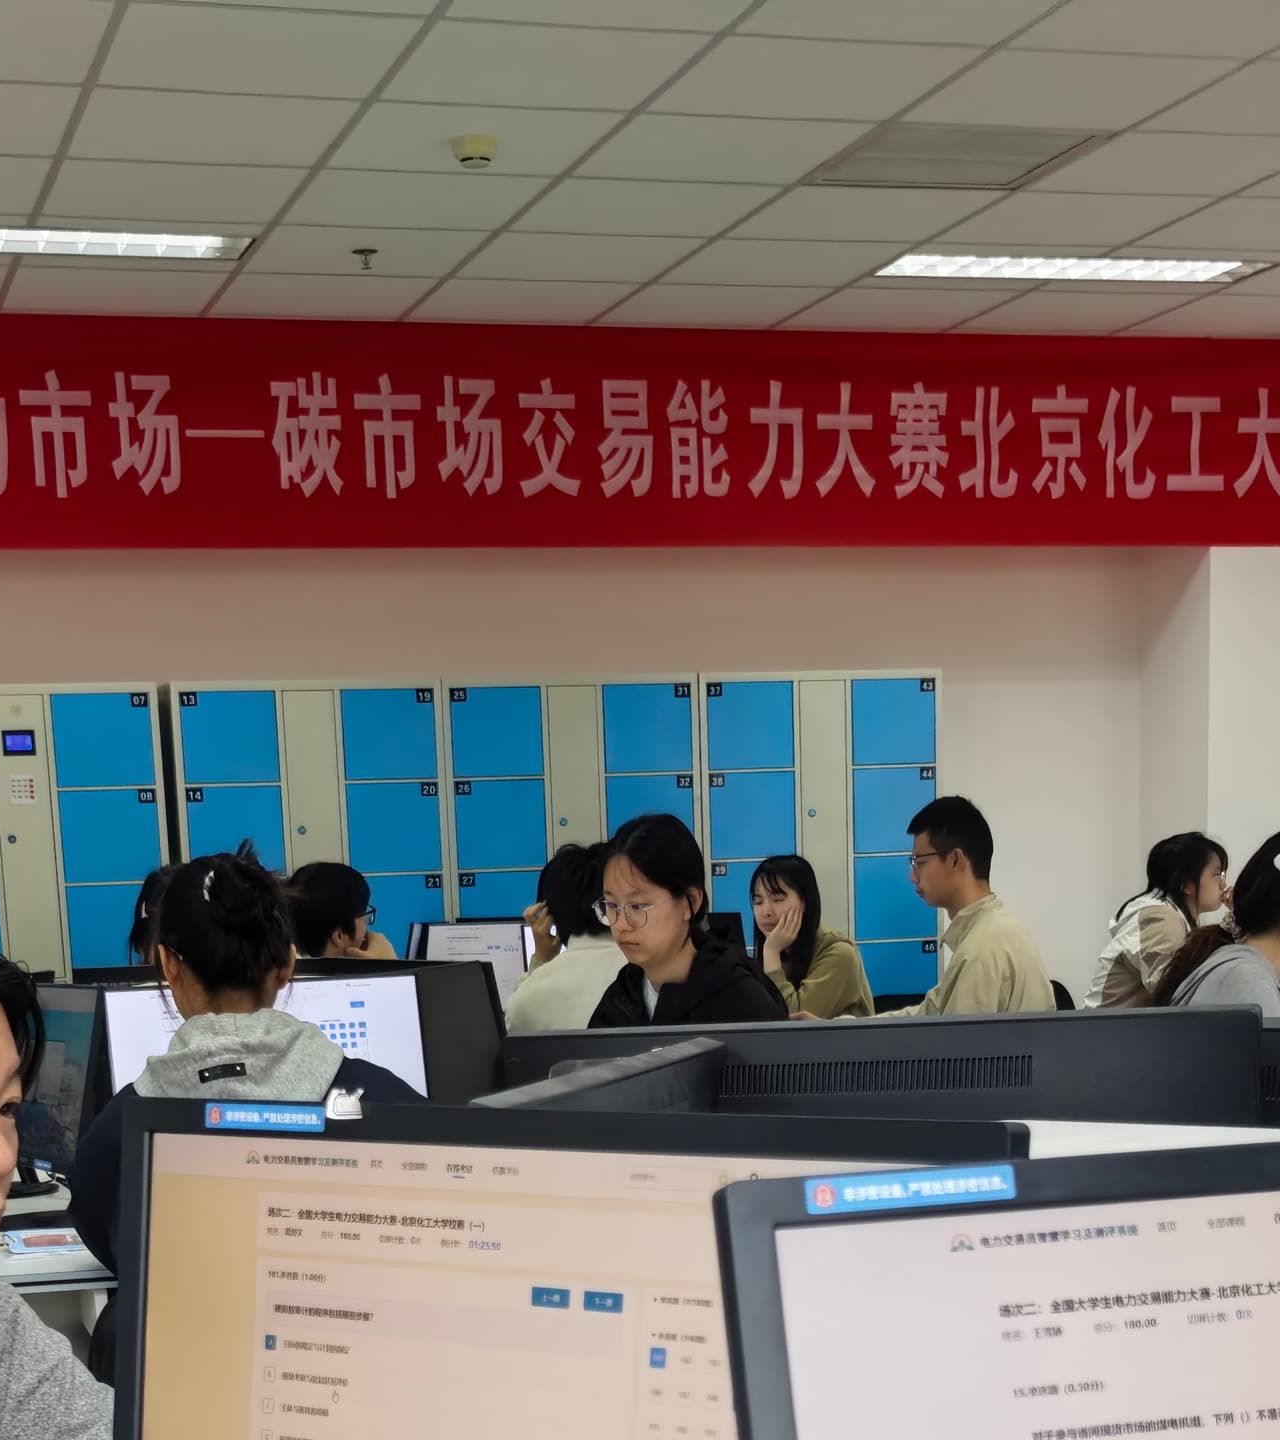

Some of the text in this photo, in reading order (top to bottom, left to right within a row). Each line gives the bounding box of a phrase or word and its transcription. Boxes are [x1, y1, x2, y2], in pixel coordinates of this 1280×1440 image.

[677, 688, 688, 696] 31
[709, 686, 720, 695] 37
[418, 692, 430, 701] 19
[453, 691, 465, 700] 25
[133, 696, 145, 705] 07
[182, 696, 195, 704] 13
[680, 778, 690, 786] 32
[423, 786, 436, 794] 20
[140, 792, 153, 800] 08
[189, 792, 201, 800] 14
[428, 878, 440, 887] 21
[462, 877, 474, 885] 27
